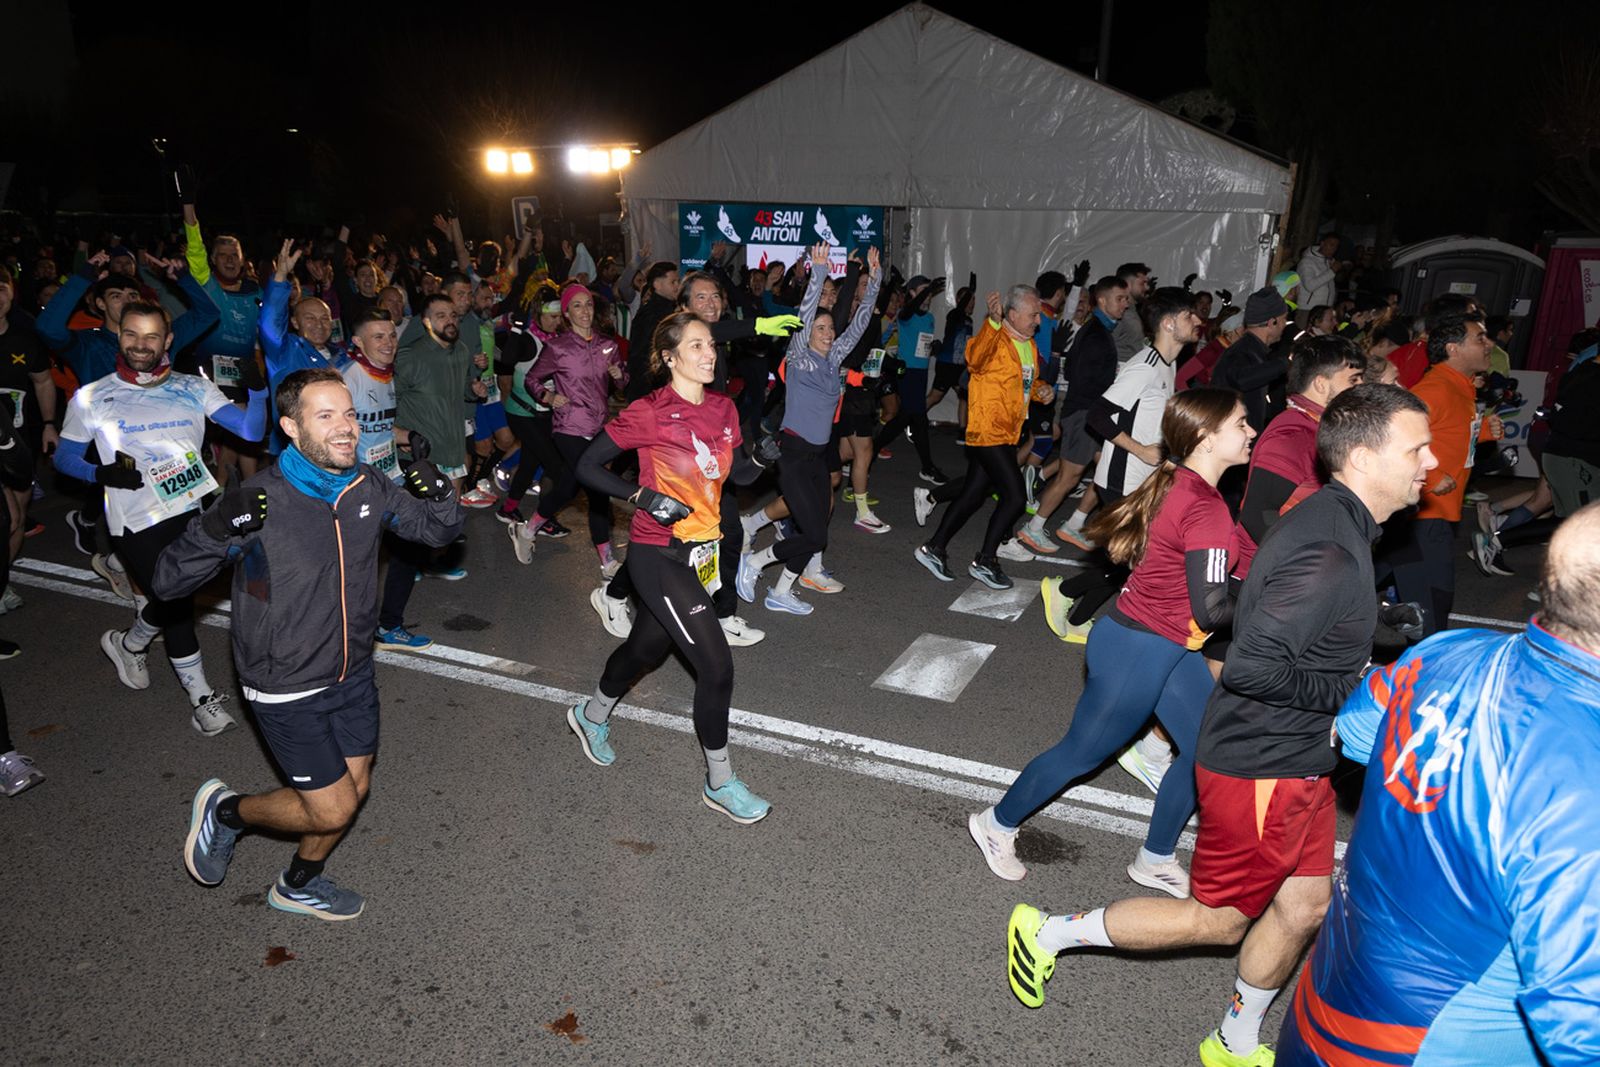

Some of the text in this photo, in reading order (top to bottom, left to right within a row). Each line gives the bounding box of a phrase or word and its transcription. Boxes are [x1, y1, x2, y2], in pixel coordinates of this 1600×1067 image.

[750, 223, 800, 242] ANTÓN
[221, 366, 240, 377] 885
[160, 464, 202, 495] 12948
